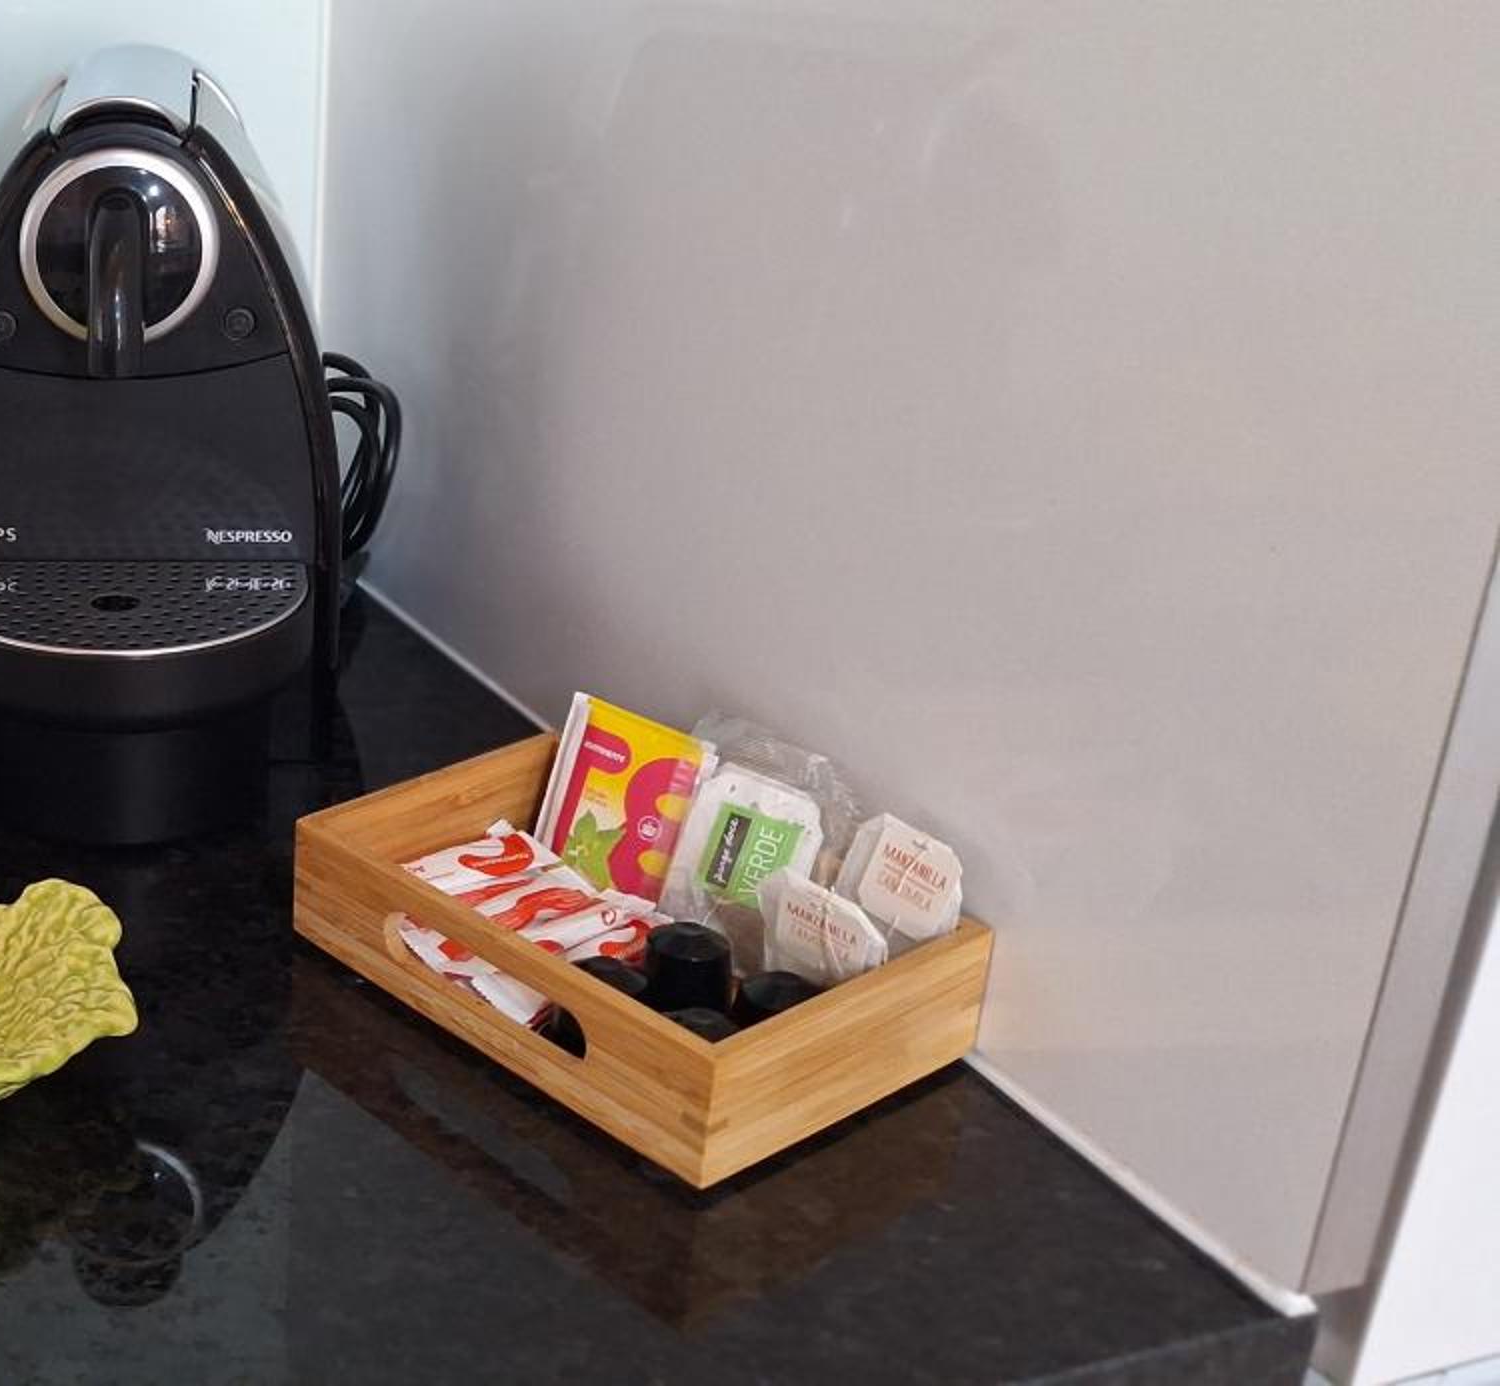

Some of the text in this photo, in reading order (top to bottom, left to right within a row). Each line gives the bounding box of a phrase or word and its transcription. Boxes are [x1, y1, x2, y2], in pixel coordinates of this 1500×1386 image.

[203, 528, 293, 545] NESPRESSO
[738, 825, 785, 894] VERDE
[882, 842, 948, 892] MANZANILLA
